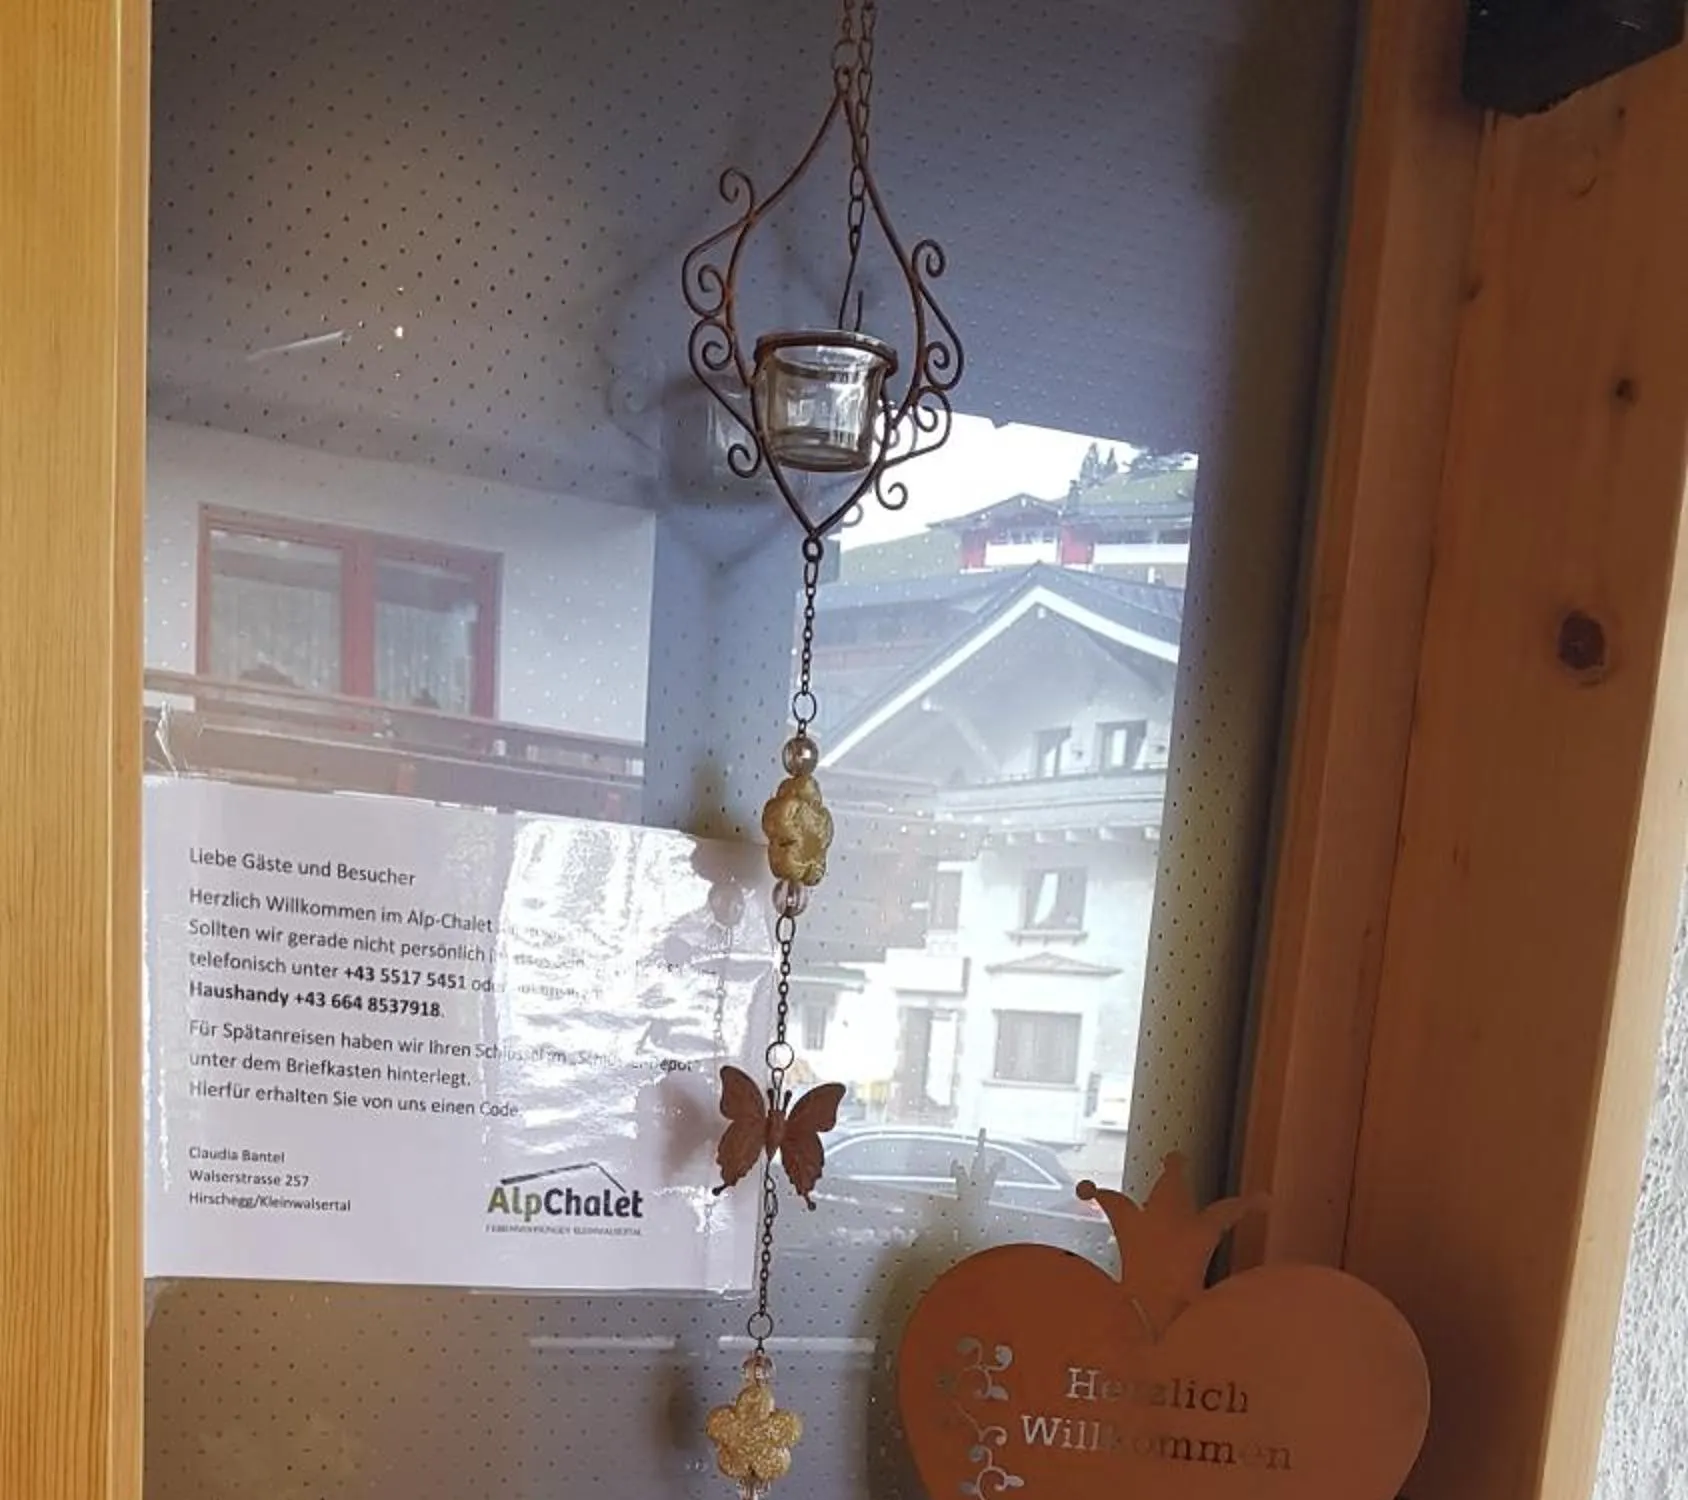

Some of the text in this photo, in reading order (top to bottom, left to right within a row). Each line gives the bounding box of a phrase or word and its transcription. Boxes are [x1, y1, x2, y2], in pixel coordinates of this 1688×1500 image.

[190, 848, 416, 886] Liebe Gäste und Besucher
[189, 888, 492, 933] Herzlich Willkommen im Alp-Chalet
[188, 919, 249, 939] Sollten
[255, 926, 284, 942] wir
[288, 930, 348, 949] gerade
[353, 935, 395, 954] nicht
[400, 943, 485, 962] persönlich
[189, 951, 286, 973] telefonisch
[292, 962, 338, 978] unter
[344, 965, 375, 982] +43
[380, 968, 421, 985] 5517
[426, 972, 465, 989] 5451
[471, 976, 505, 993] odr
[189, 980, 445, 1018] Haushandy +43 664 8537918.
[189, 1019, 218, 1037] Für
[223, 1022, 335, 1046] Spätanreisen
[341, 1032, 393, 1050] haben
[398, 1037, 424, 1054] wir
[429, 1040, 471, 1057] Ihren
[189, 1053, 471, 1088] unter dem Briefkasten hinterlegt.
[190, 1080, 250, 1099] Hierfür
[255, 1086, 328, 1105] erhalten
[333, 1091, 357, 1107] Sie
[361, 1096, 393, 1110] von
[398, 1099, 426, 1112] uns
[431, 1100, 475, 1115] einen
[189, 1146, 285, 1163] Claudia Bantel
[189, 1169, 309, 1187] Walserstrasse 257
[189, 1191, 351, 1212] Hirschegg/Kleinwalsertal
[488, 1186, 643, 1222] AlpChalet
[1066, 1367, 1249, 1413] Hezlich
